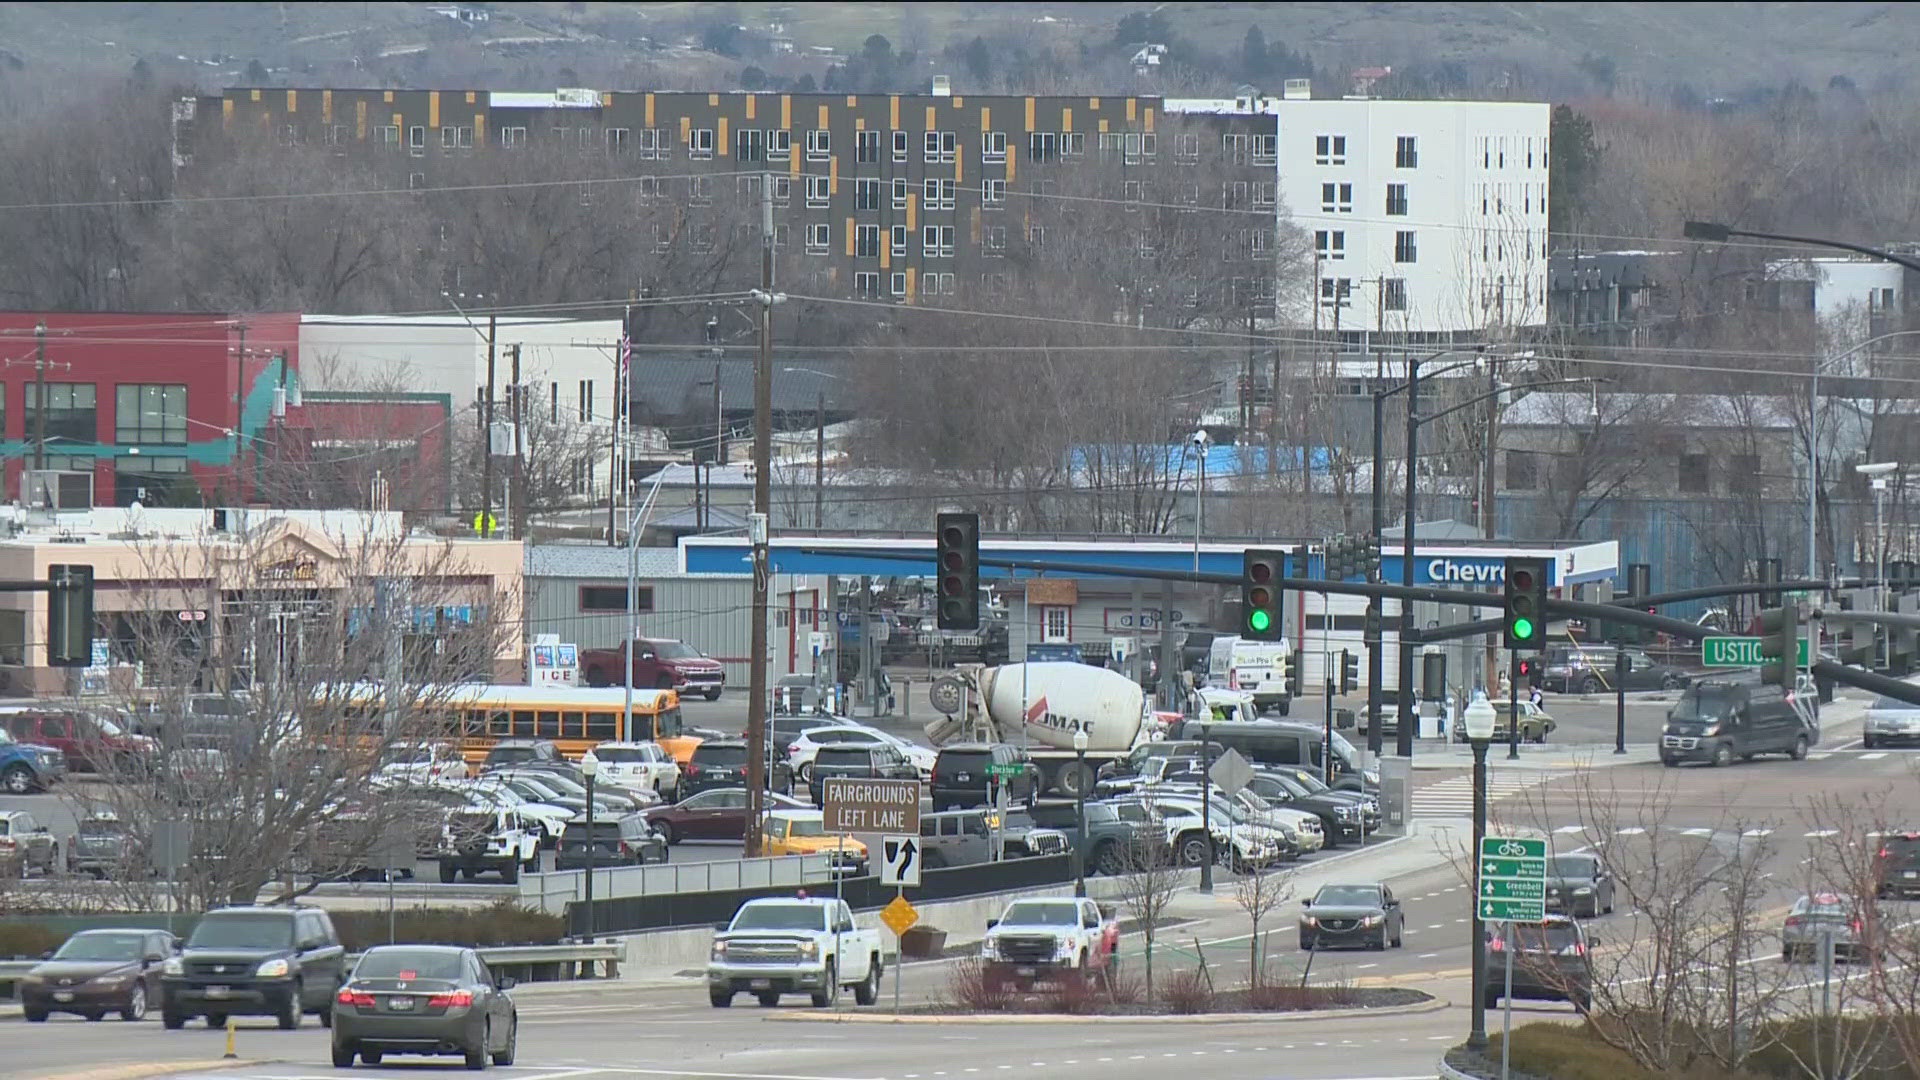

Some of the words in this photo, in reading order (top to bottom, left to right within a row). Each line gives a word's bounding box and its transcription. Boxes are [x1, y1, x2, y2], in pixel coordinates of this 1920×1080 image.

[1428, 559, 1506, 581] Chevr
[1714, 641, 1776, 662] USTIC
[542, 670, 571, 681] ICE
[829, 785, 914, 804] FAIRGROUNDS
[838, 808, 866, 828] LEFT
[873, 810, 905, 828] LANE
